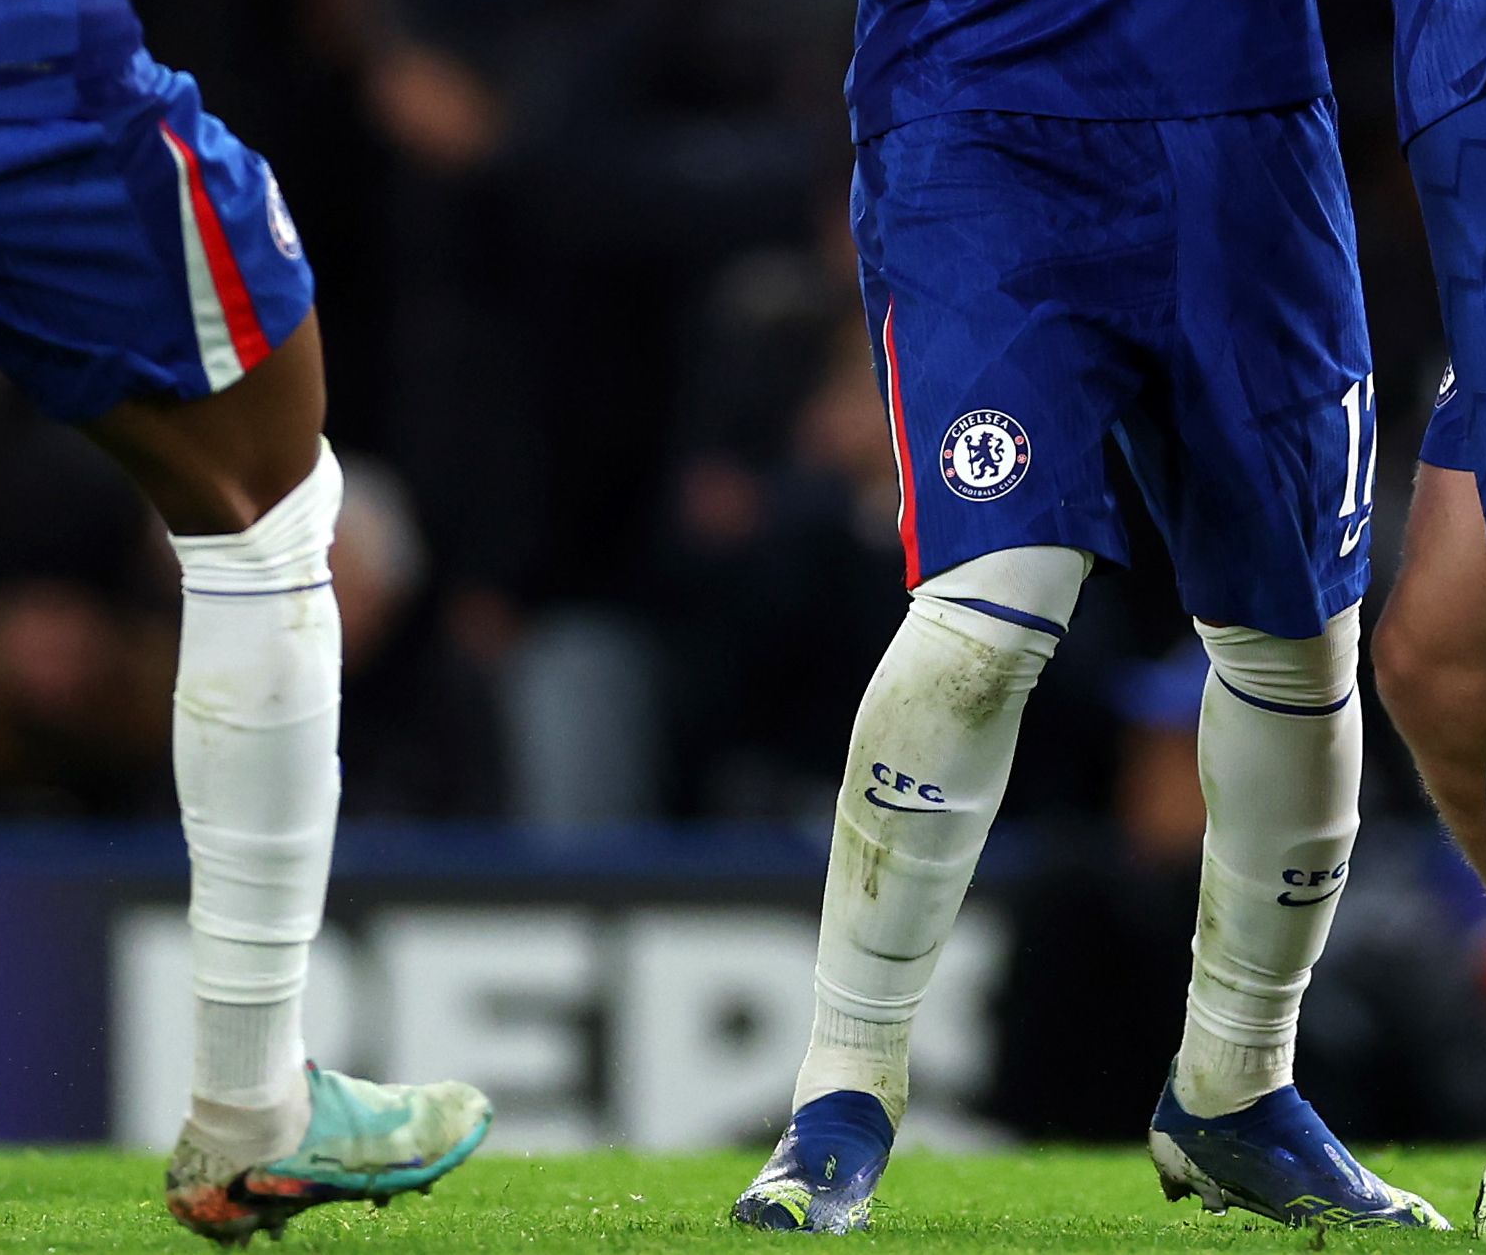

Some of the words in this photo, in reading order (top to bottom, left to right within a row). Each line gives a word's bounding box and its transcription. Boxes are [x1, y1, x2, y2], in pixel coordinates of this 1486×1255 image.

[951, 413, 1010, 438] CHELSEA
[957, 484, 996, 497] FOOTBALL
[999, 474, 1018, 491] CLUB
[872, 761, 945, 804] CFC
[1282, 860, 1349, 888] CFC
